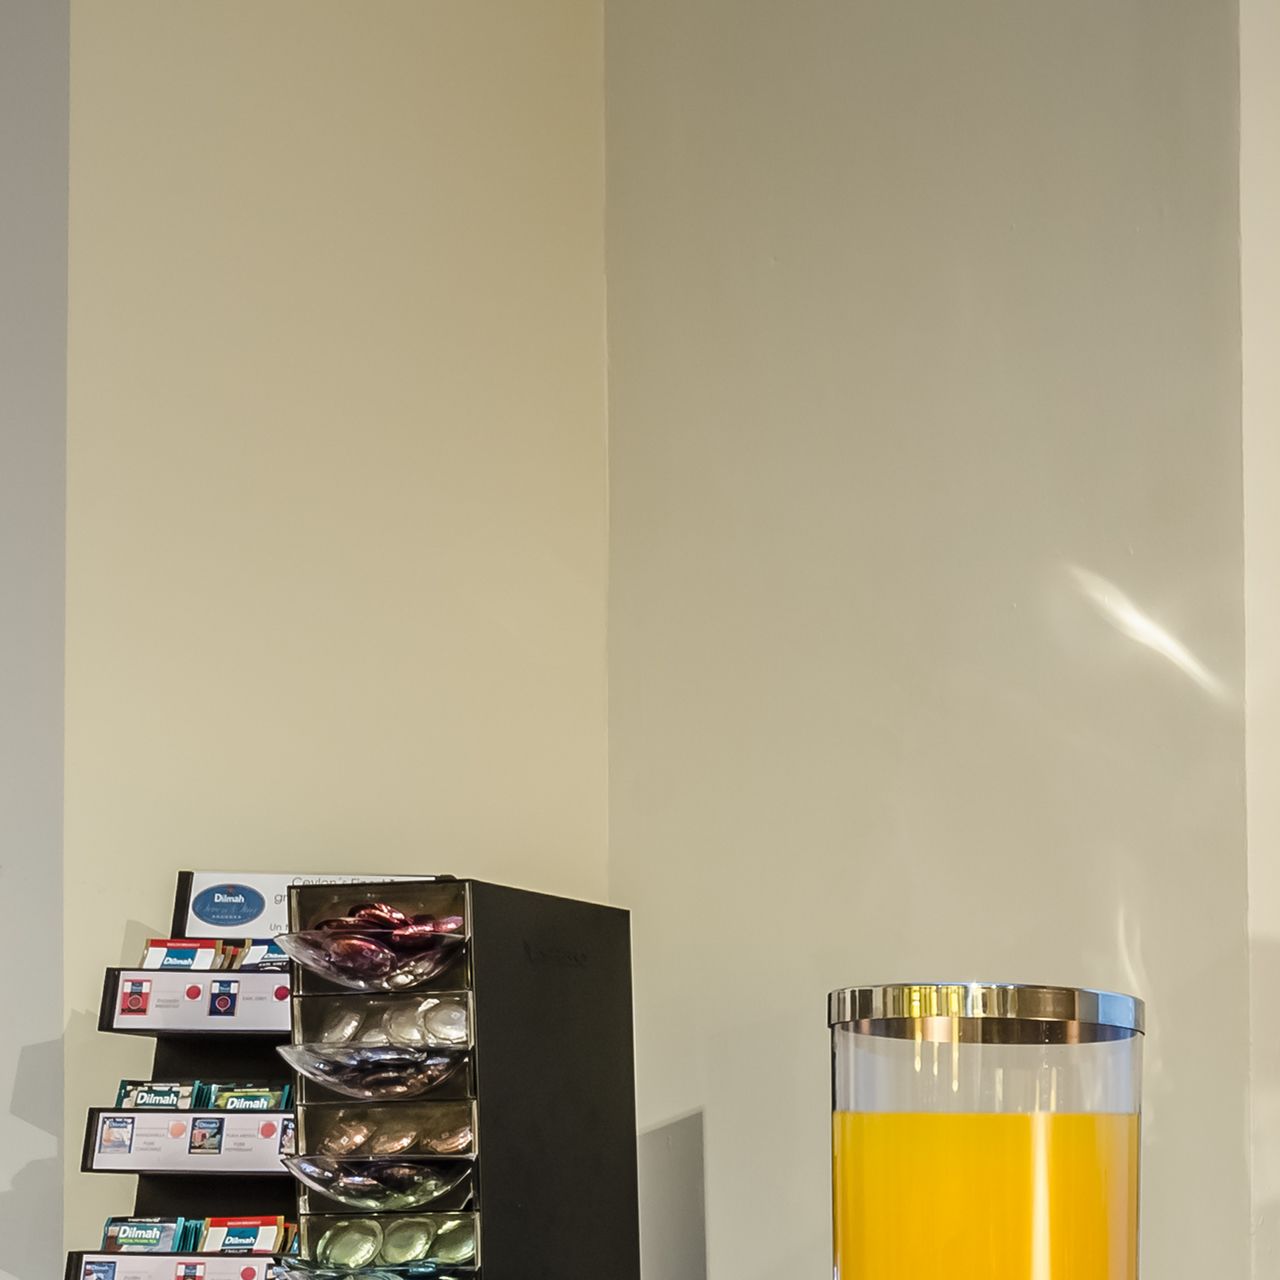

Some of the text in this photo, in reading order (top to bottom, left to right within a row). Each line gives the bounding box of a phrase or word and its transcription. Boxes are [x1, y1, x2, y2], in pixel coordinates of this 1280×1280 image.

[214, 893, 245, 903] Dilmah
[164, 956, 193, 965] Dilmah
[136, 1092, 178, 1104] Dilmah
[226, 1097, 268, 1109] Dilmah
[119, 1226, 160, 1238] Dilmah
